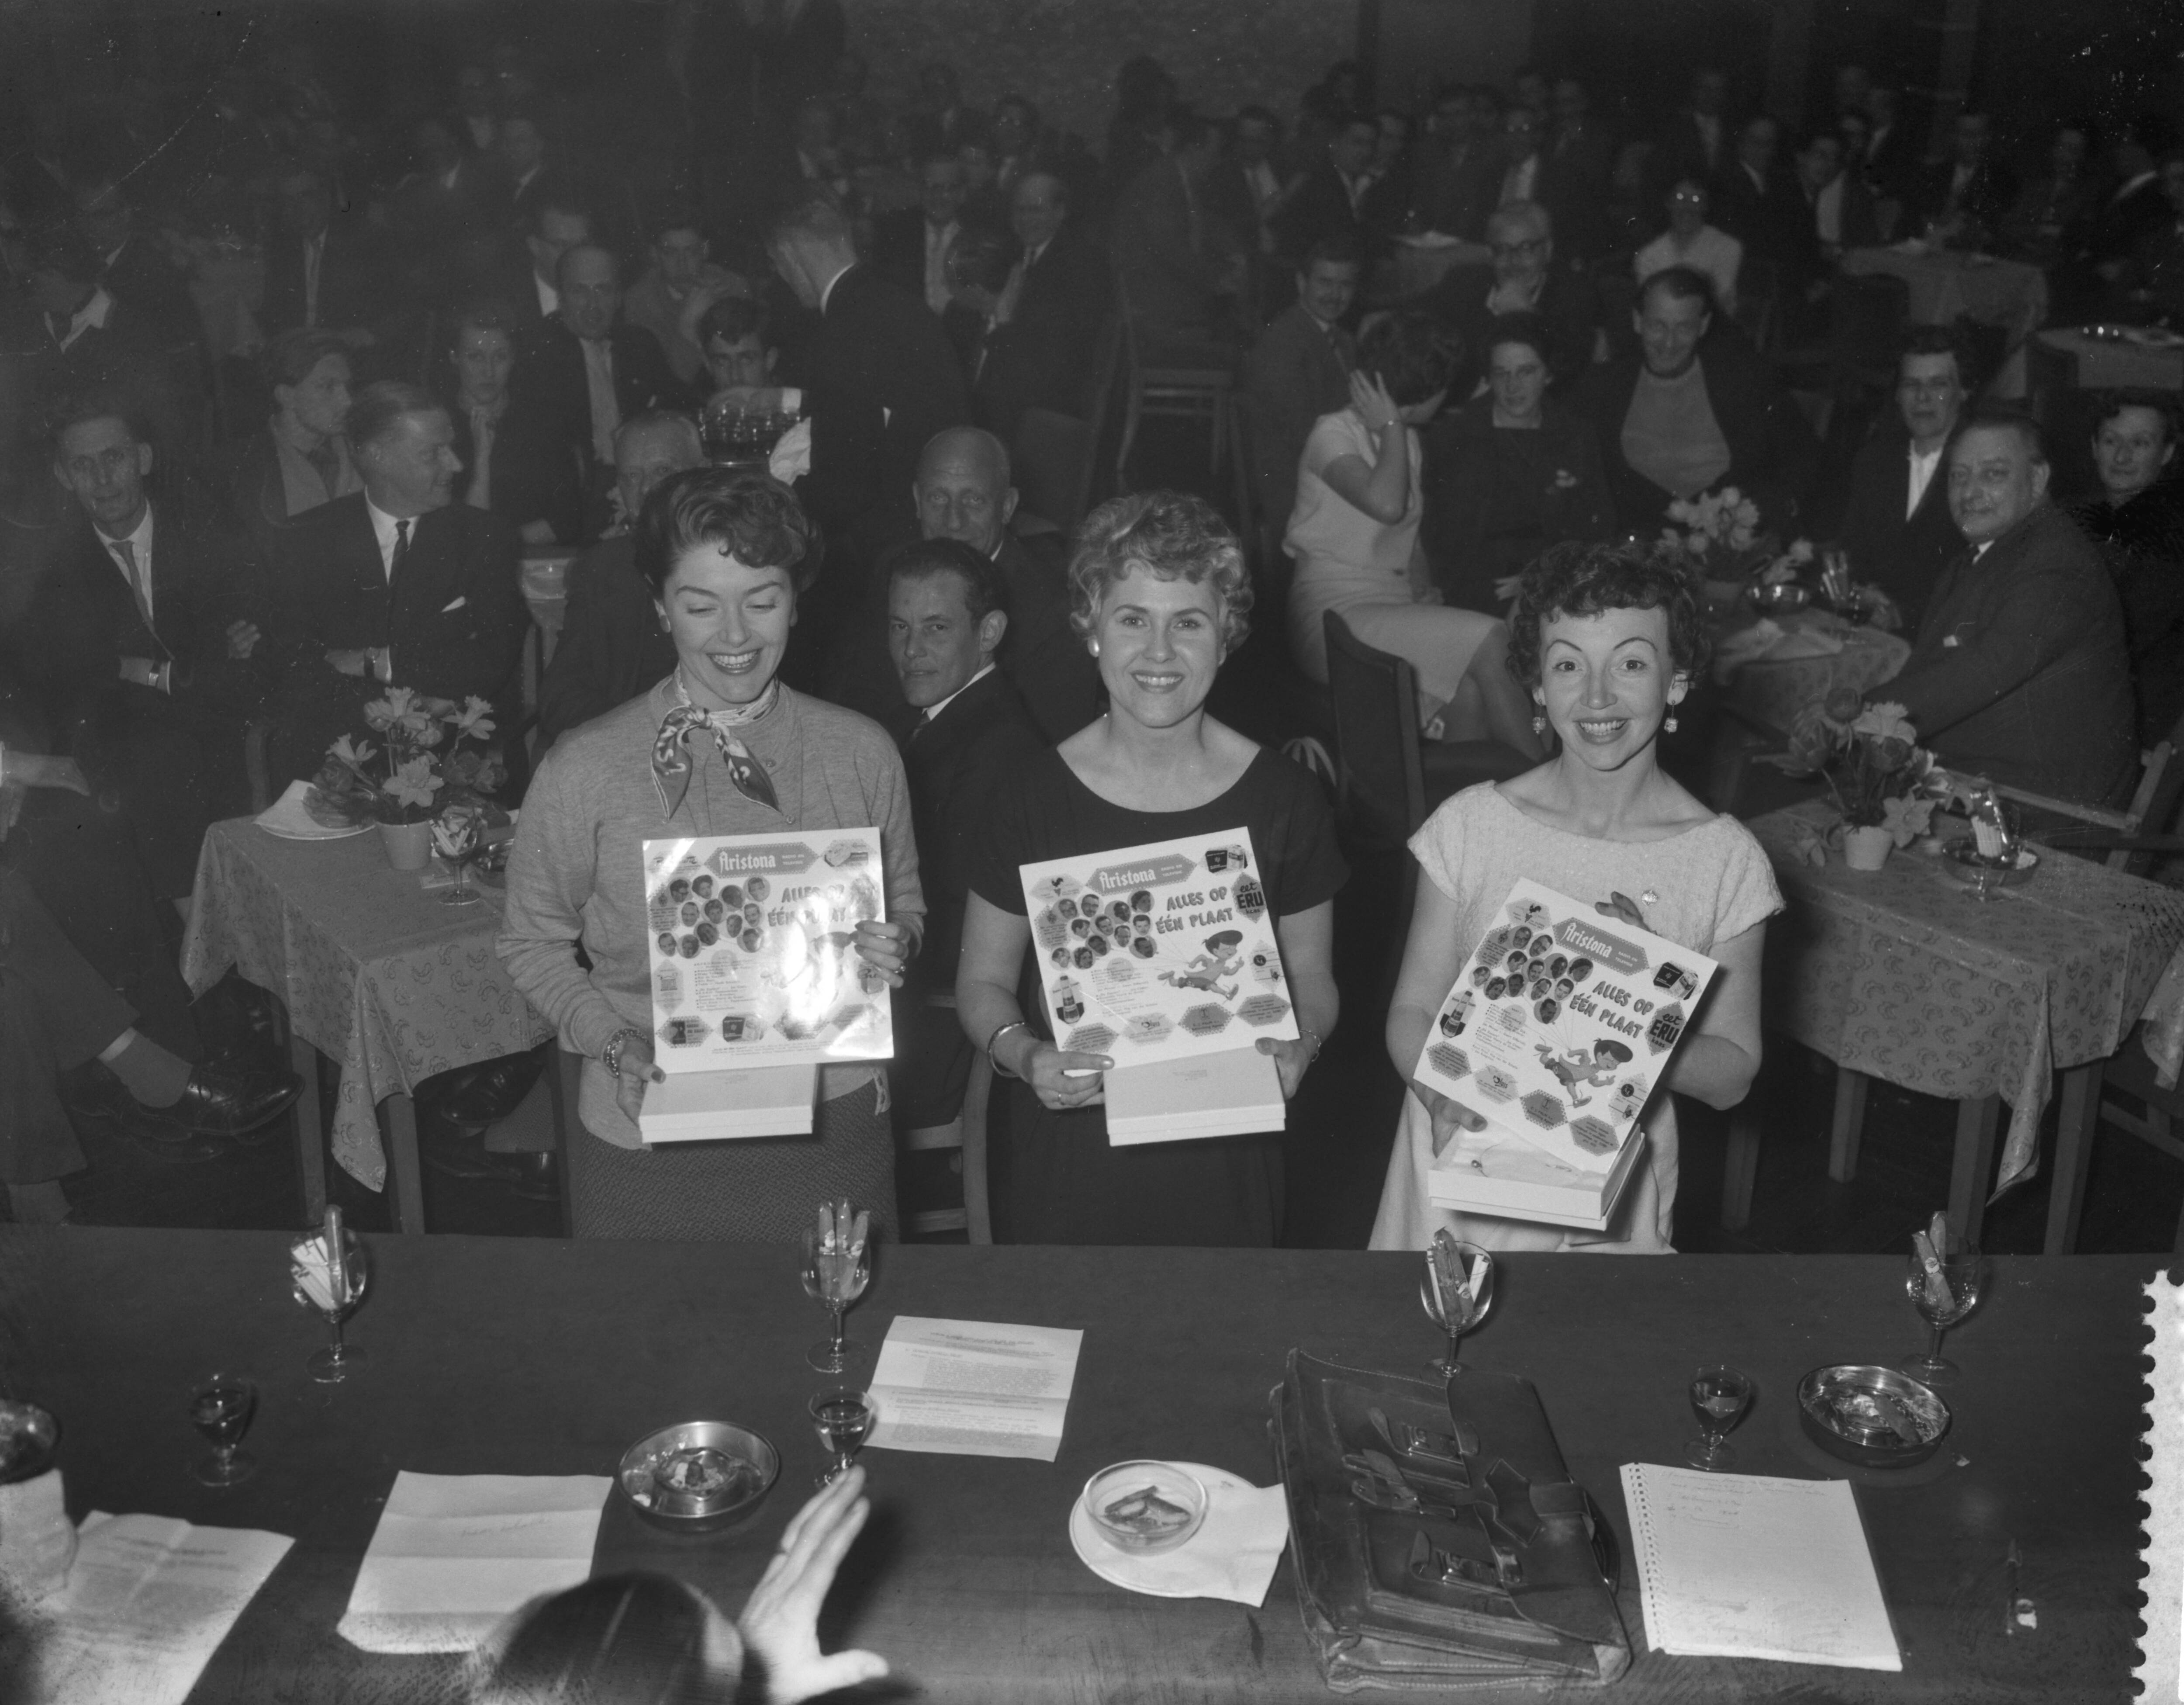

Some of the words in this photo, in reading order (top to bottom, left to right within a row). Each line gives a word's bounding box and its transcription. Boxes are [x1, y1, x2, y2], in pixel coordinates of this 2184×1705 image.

[719, 851, 776, 873] Aristona
[1099, 869, 1157, 892] Aristona
[1240, 882, 1258, 892] eet
[1167, 892, 1204, 911] ALLES
[1209, 886, 1227, 901] OP
[1237, 891, 1264, 909] ERU
[1155, 914, 1184, 934] ÉÉN
[1189, 908, 1233, 927] PLAAT
[1560, 922, 1612, 958] Aristona
[1618, 951, 1631, 959] RADIO
[1592, 981, 1632, 1006] ALLES
[1634, 998, 1654, 1015] OP
[1569, 993, 1598, 1017] ÉÉN
[1599, 1009, 1644, 1038] PLAAT
[1662, 1013, 1683, 1025] eet
[1649, 1019, 1680, 1044] ERU
[1652, 1037, 1665, 1048] kaas
